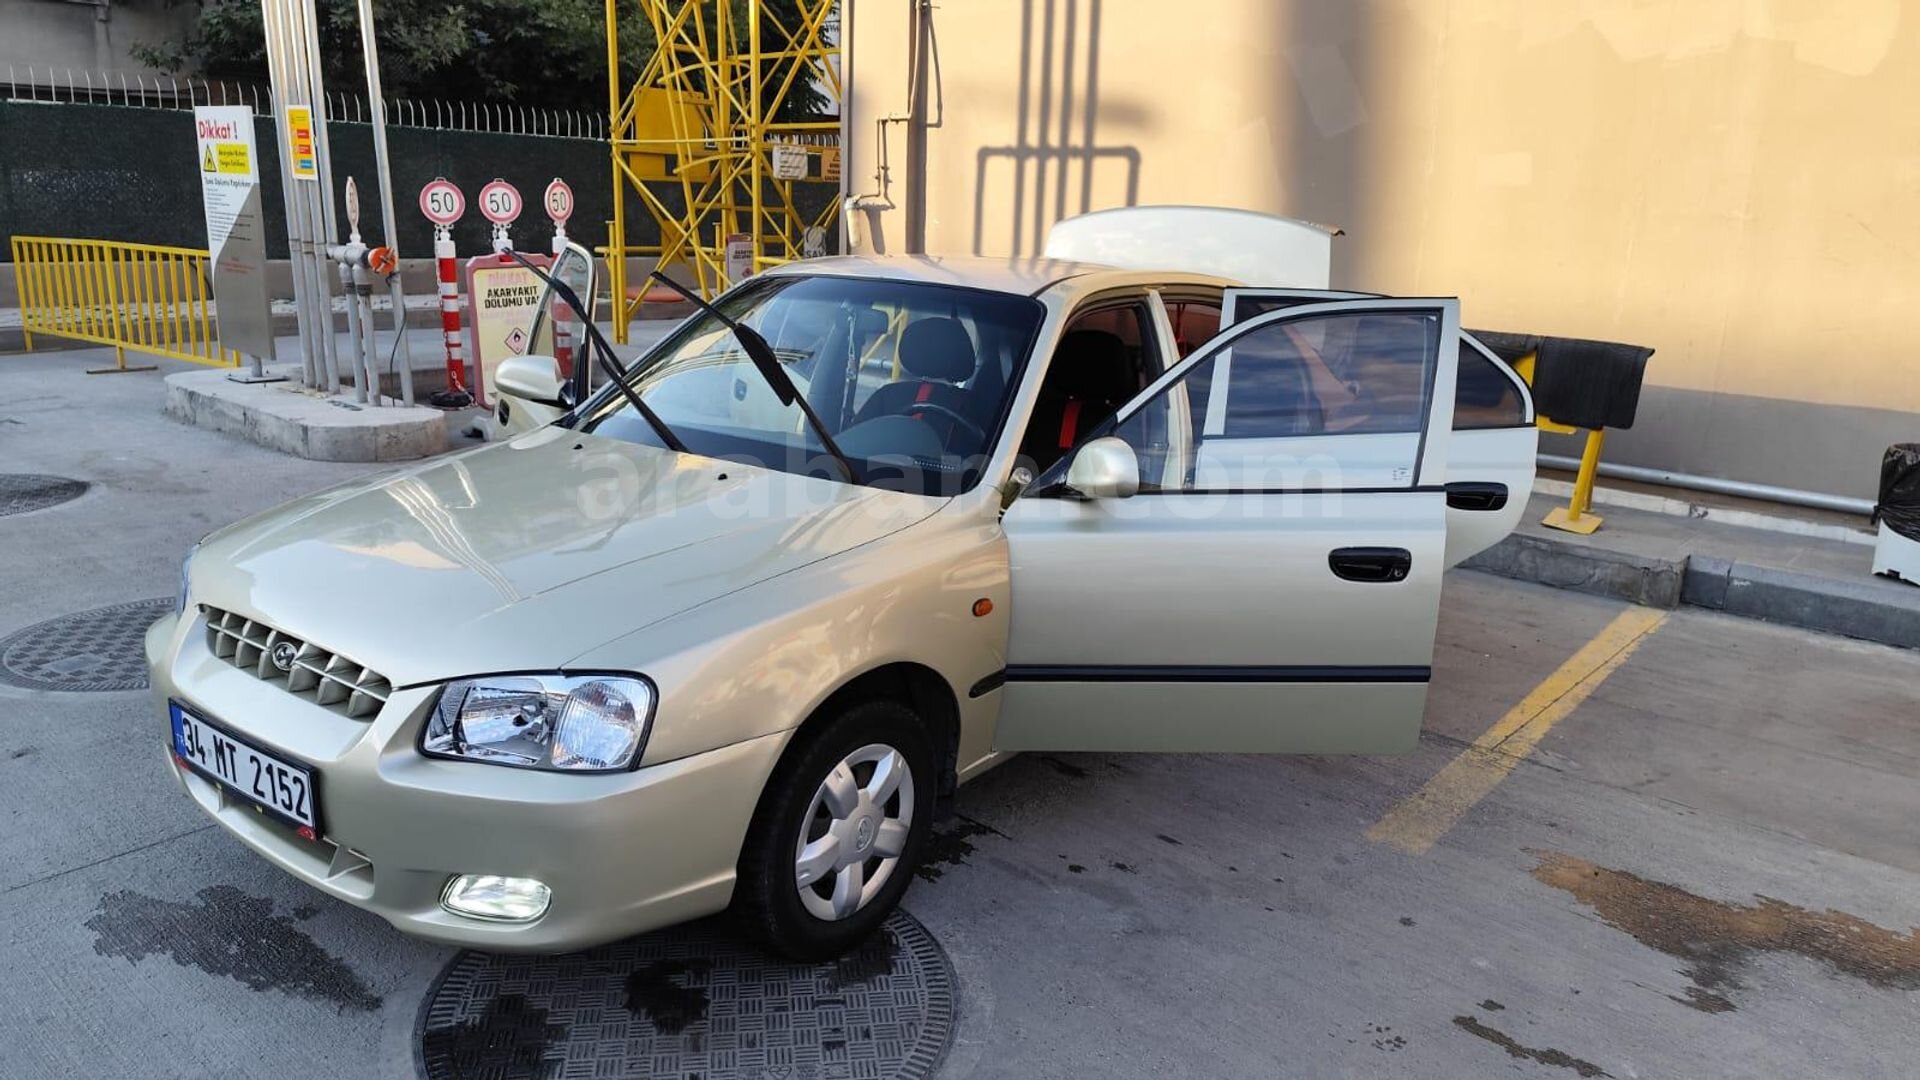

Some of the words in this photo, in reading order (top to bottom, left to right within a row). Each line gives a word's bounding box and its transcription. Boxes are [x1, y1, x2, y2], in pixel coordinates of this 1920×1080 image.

[198, 118, 231, 139] Dikkat
[430, 192, 454, 213] 50
[489, 192, 512, 213] 50
[551, 191, 567, 212] 50
[487, 285, 538, 298] AKARYAKIT
[484, 297, 523, 309] DOLUMU
[183, 717, 206, 765] 34
[213, 734, 237, 783] MT
[250, 755, 309, 820] 2152
